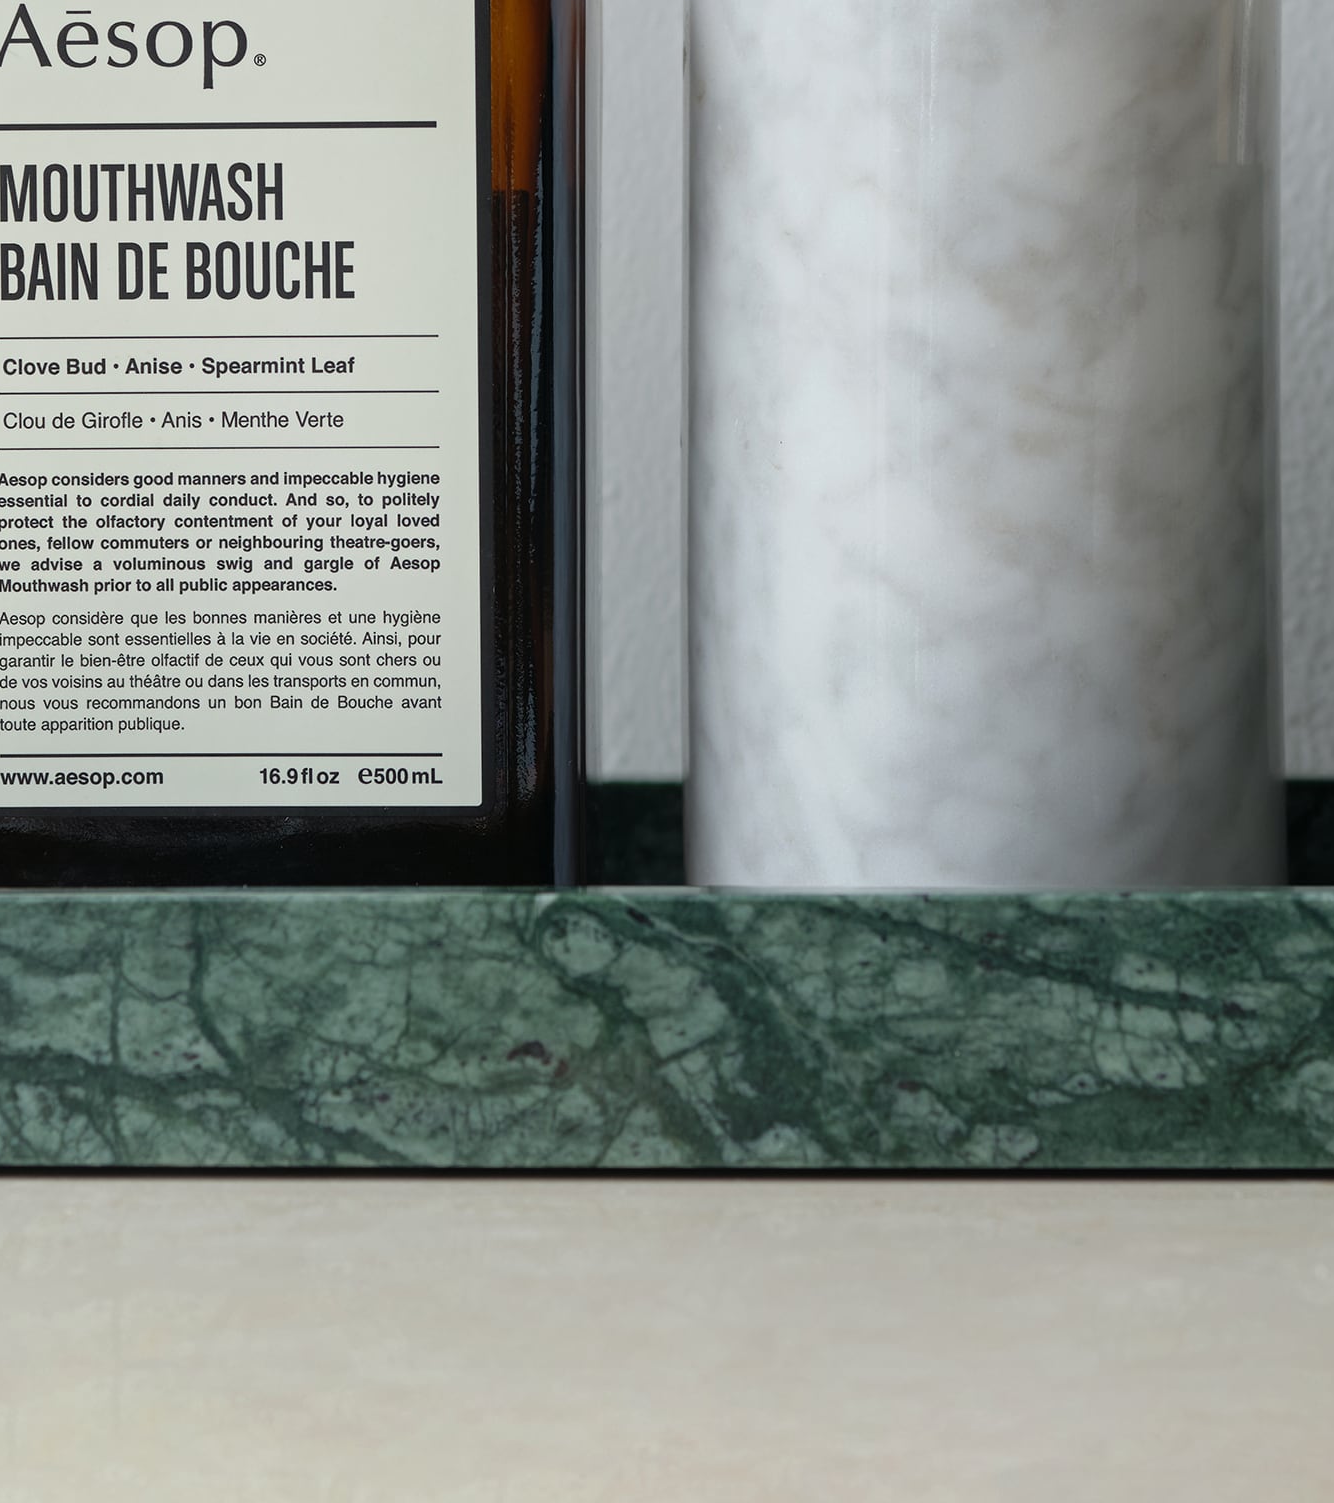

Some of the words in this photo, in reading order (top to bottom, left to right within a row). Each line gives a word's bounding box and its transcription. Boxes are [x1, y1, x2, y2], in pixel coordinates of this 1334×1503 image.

[0, 161, 284, 223] MOUTHWASH
[0, 242, 99, 301] BAIN
[117, 241, 169, 301] DE
[185, 240, 356, 301] BOUCHE
[2, 358, 61, 376] Clove
[66, 357, 107, 376] Bud
[124, 357, 183, 375] Anise
[201, 356, 306, 379] Spearmint
[311, 356, 356, 374] Leaf
[3, 411, 46, 430] Clou
[51, 411, 76, 430] de
[81, 411, 143, 430] Girofle
[160, 411, 203, 429] Anis
[221, 410, 290, 429] Menthe
[295, 410, 344, 428] Verte
[51, 472, 130, 487] considers
[133, 471, 174, 490] good
[177, 474, 247, 486] manners
[250, 471, 280, 486] and
[283, 471, 374, 489] impeccable
[377, 470, 441, 489] hygiene
[75, 494, 93, 508] to
[100, 493, 154, 508] cordial
[162, 492, 201, 511] daily
[208, 492, 278, 507] conduct.
[285, 492, 318, 507] And
[325, 495, 350, 509] so,
[357, 492, 374, 507] to
[381, 491, 440, 510] politely
[61, 514, 88, 529] the
[95, 514, 166, 532] olfactory
[173, 514, 274, 529] contentment
[281, 513, 298, 528] of
[305, 516, 343, 532] your
[350, 513, 388, 531] loyal
[397, 513, 440, 528] loved
[46, 535, 95, 551] fellow
[100, 536, 190, 550] commuters
[195, 538, 213, 550] or
[218, 535, 324, 553] neighbouring
[329, 534, 441, 552] theatre-goers,
[30, 557, 83, 572] advise
[92, 559, 103, 572] a
[112, 556, 206, 571] voluminous
[216, 556, 253, 574] swig
[263, 556, 293, 571] and
[303, 555, 354, 574] gargle
[363, 555, 381, 570] of
[389, 555, 441, 574] Aesop
[93, 578, 132, 596] prior
[135, 578, 152, 592] to
[155, 577, 175, 592] all
[179, 577, 228, 596] public
[232, 580, 338, 595] appearances.
[51, 610, 124, 626] considère
[130, 613, 159, 628] que
[164, 610, 187, 625] les
[192, 610, 248, 625] bonnes
[253, 609, 322, 625] manières
[327, 610, 342, 625] et
[348, 613, 377, 625] une
[382, 609, 441, 628] hygiène
[87, 632, 120, 647] sont
[124, 631, 212, 646] essentielles
[216, 631, 227, 646] à
[231, 631, 245, 646] la
[249, 631, 272, 646] vie
[276, 634, 295, 646] en
[300, 631, 357, 646] société.
[361, 631, 402, 648] Ainsi,
[407, 634, 442, 649] pour
[61, 653, 75, 668] le
[79, 652, 146, 668] bien-être
[151, 652, 200, 667] olfactif
[204, 652, 224, 667] de
[228, 655, 265, 667] ceux
[269, 652, 292, 670] qui
[297, 655, 334, 667] vous
[339, 653, 371, 667] sont
[376, 652, 418, 667] chers
[422, 655, 441, 667] ou
[21, 677, 48, 689] vos
[51, 674, 103, 689] voisins
[106, 677, 125, 689] au
[129, 673, 181, 689] théâtre
[184, 676, 204, 689] ou
[207, 673, 244, 689] dans
[248, 673, 270, 688] les
[273, 674, 347, 692] transports
[350, 676, 369, 688] en
[373, 676, 441, 690] commun,
[0, 699, 36, 711] nous
[42, 698, 79, 711] vous
[86, 695, 201, 710] recommandons
[208, 698, 227, 710] un
[234, 695, 262, 710] bon
[270, 694, 303, 710] Bain
[310, 695, 330, 710] de
[337, 694, 394, 710] Bouche
[401, 695, 443, 710] avant
[0, 717, 37, 732] toute
[40, 716, 114, 735] apparition
[118, 716, 185, 734] publique.
[0, 771, 164, 790] www.aesop.com
